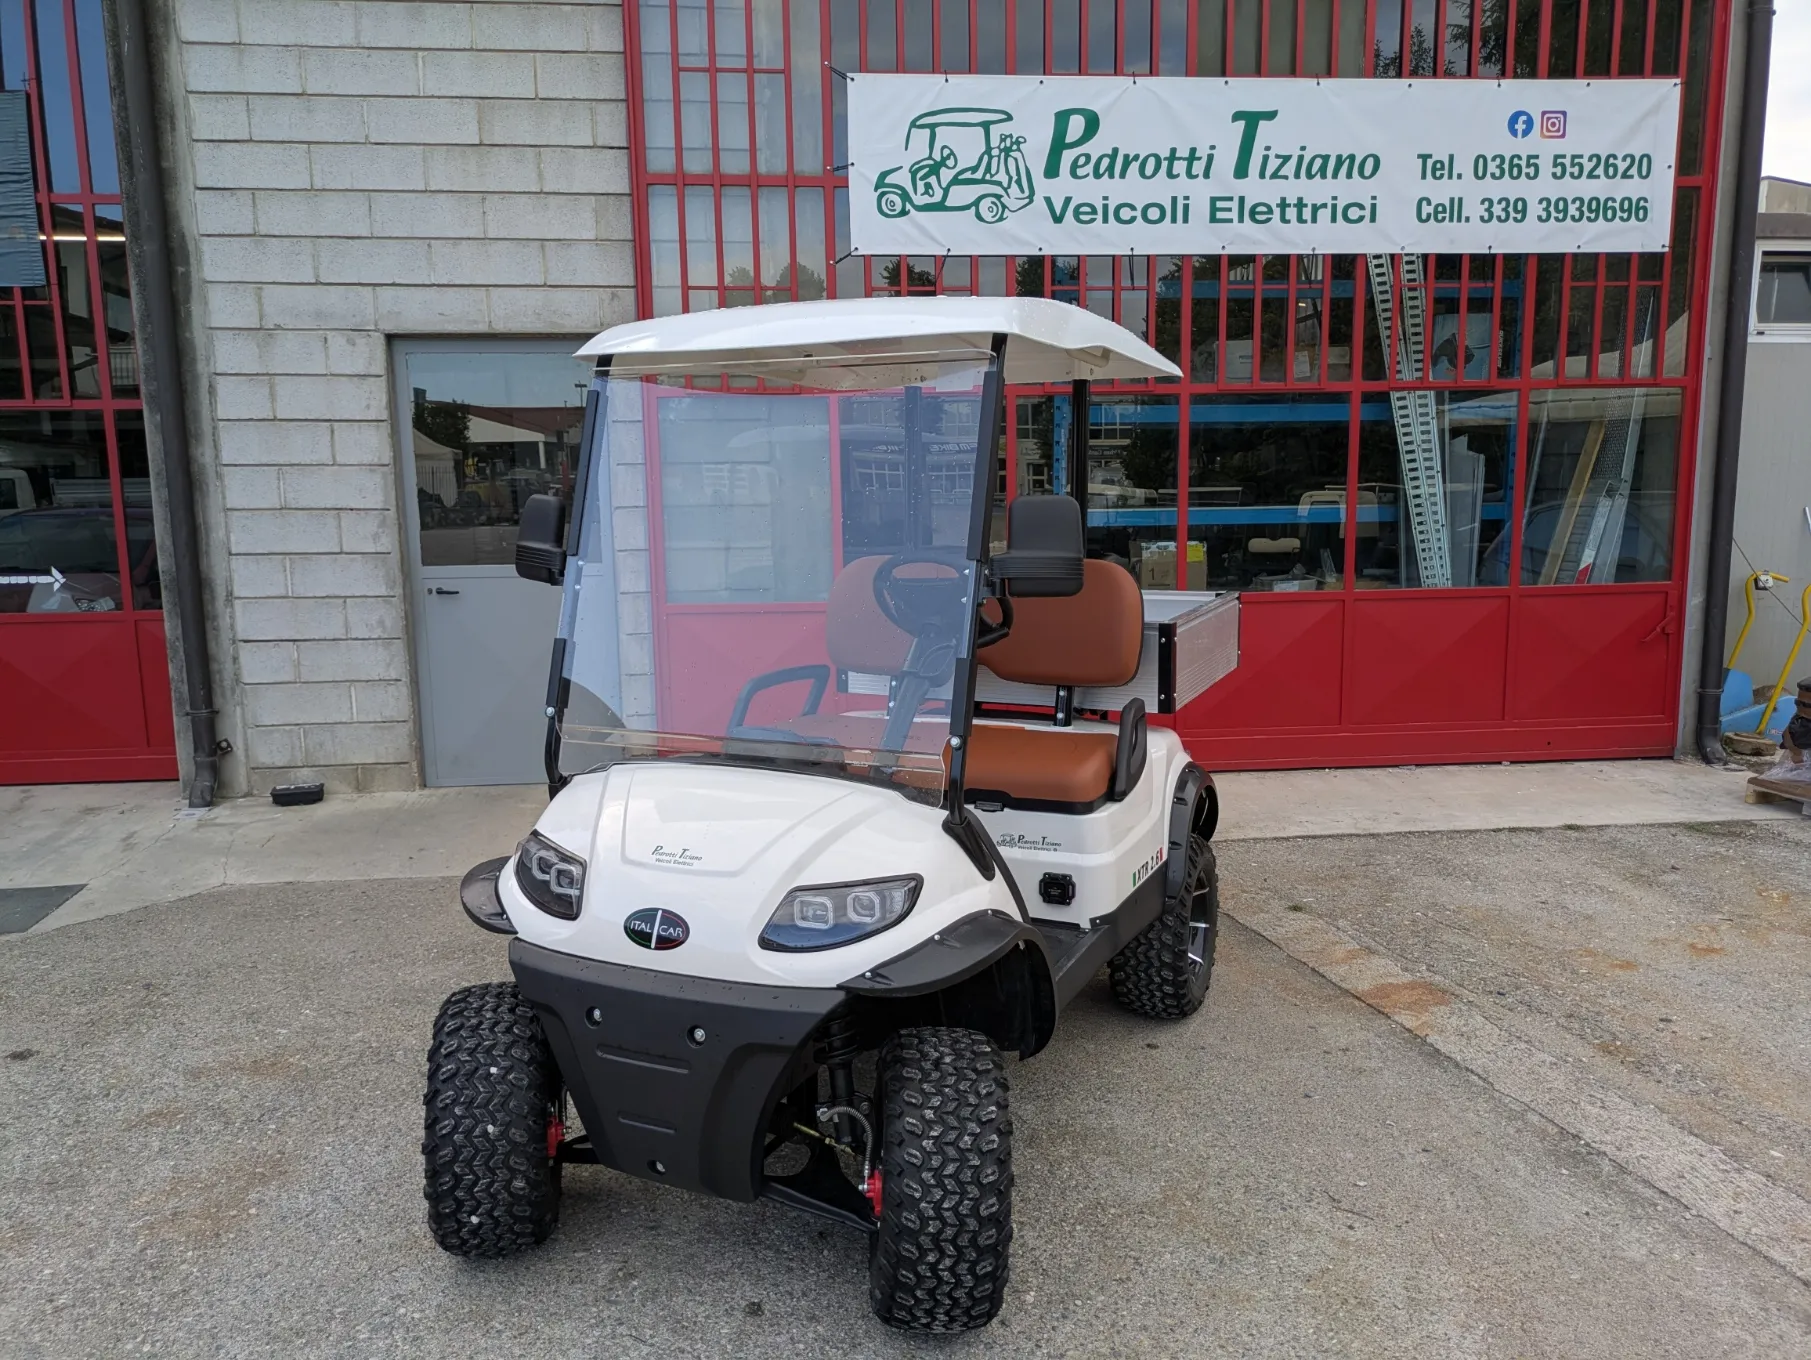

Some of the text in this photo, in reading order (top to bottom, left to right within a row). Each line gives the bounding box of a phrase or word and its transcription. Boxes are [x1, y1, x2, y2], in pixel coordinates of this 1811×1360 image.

[1043, 107, 1381, 181] Pedrotti Tiziano
[1416, 153, 1652, 181] Tel. 0365 552620
[1041, 195, 1378, 225] Veicoli Elettrici
[1415, 196, 1649, 224] Cell. 339 3939696
[651, 845, 703, 861] Pedrotti Tiziano
[1041, 836, 1062, 847] Tiziano
[1136, 861, 1149, 884] XTR
[630, 920, 683, 938] ITAL CAR
